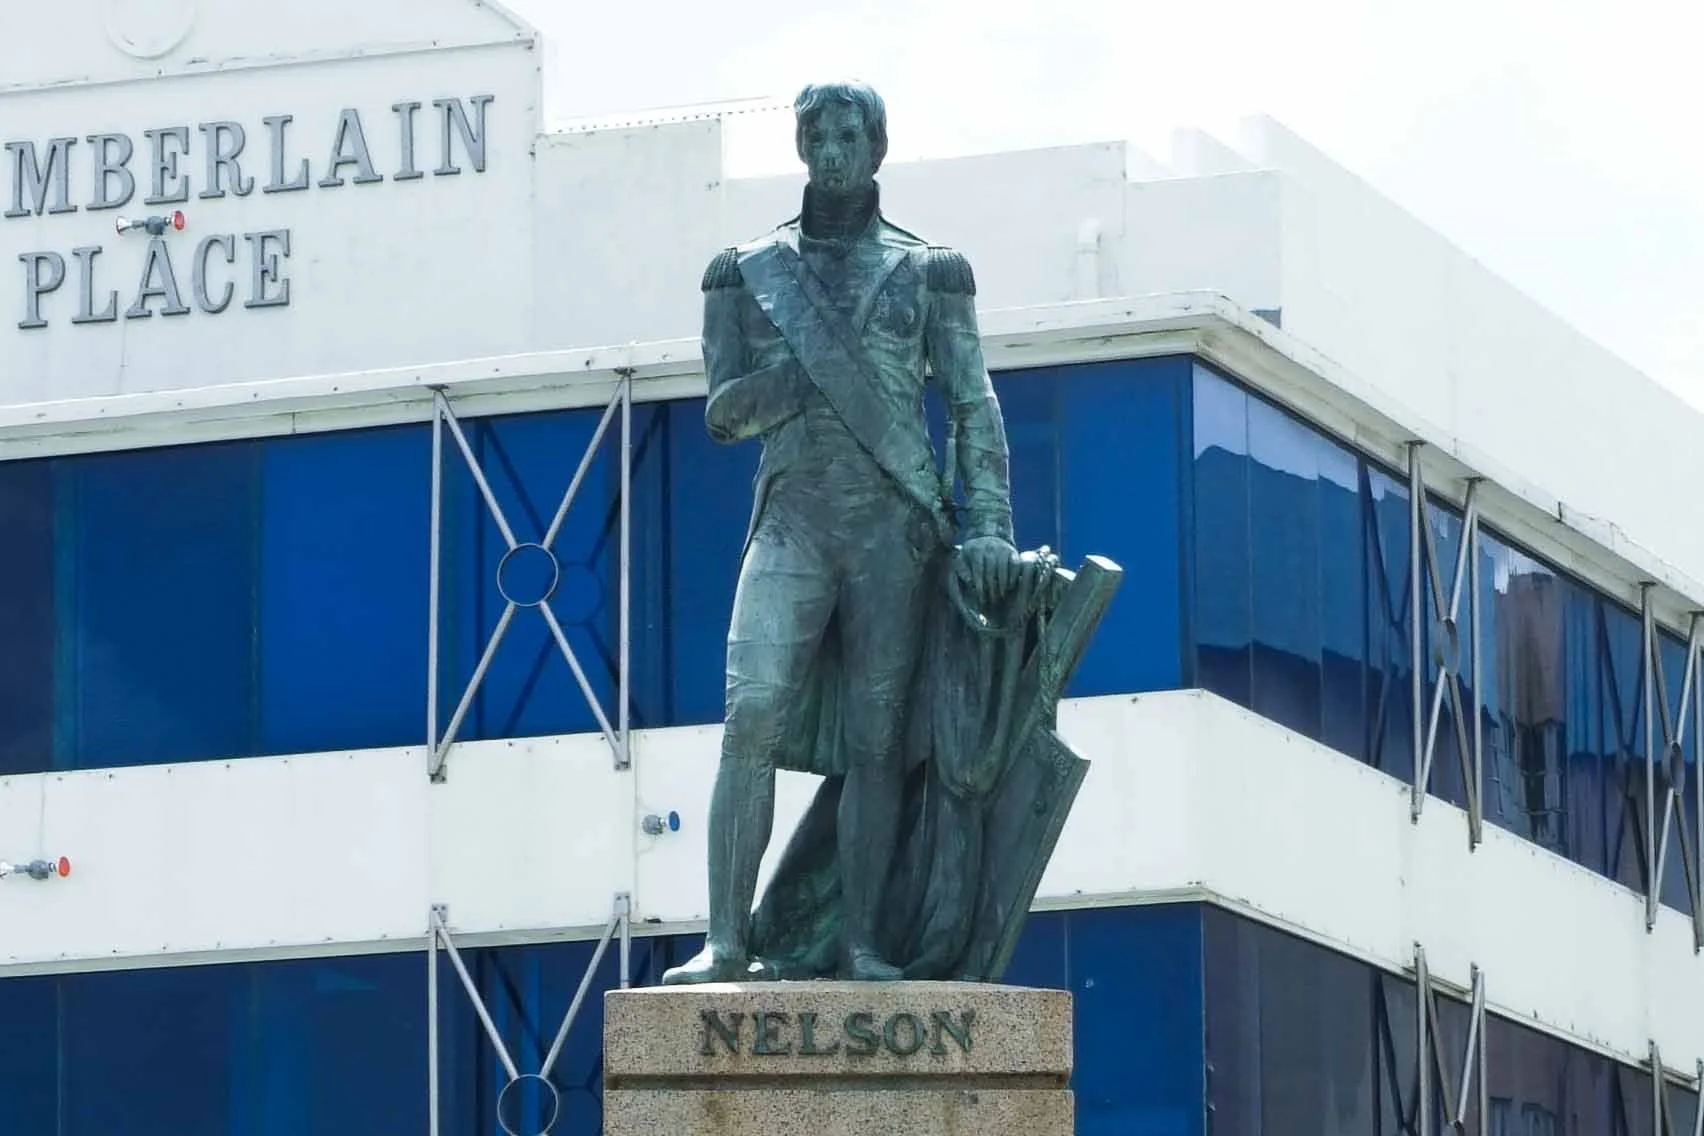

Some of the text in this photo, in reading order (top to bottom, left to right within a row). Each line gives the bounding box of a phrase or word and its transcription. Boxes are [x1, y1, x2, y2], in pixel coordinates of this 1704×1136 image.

[3, 94, 495, 218] MBERLAIN
[17, 229, 291, 329] PLACE
[700, 1008, 977, 1058] NELSON
